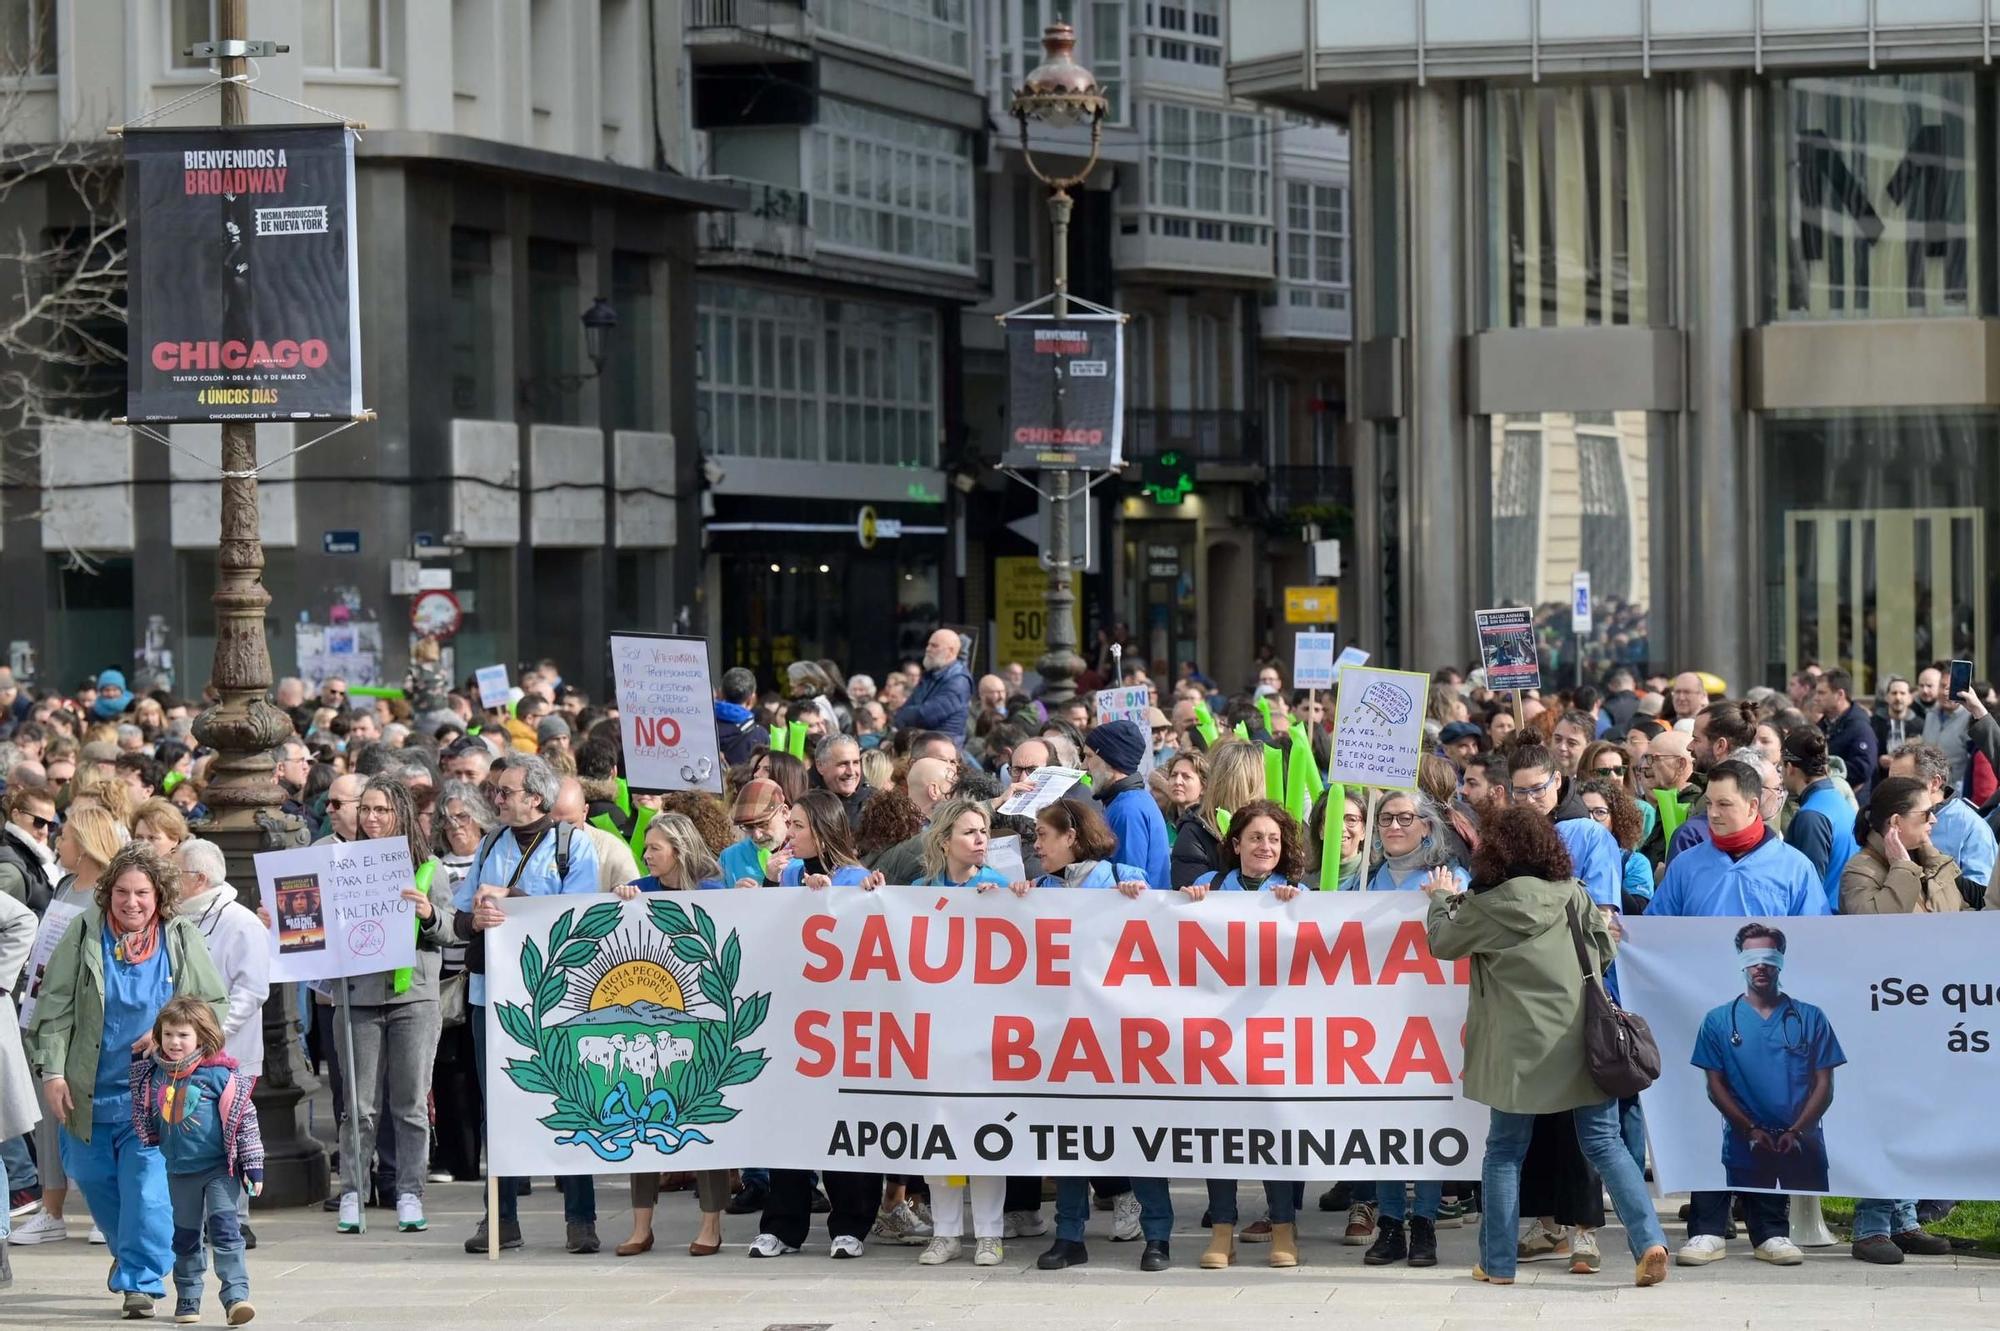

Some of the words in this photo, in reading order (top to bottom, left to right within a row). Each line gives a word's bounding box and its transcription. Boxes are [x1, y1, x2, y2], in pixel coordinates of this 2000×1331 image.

[184, 149, 276, 170] BIENVENIDOS
[277, 149, 287, 167] A
[185, 169, 287, 195] BROADWAY
[261, 211, 283, 220] MISMA
[283, 208, 323, 219] PRODUCCIÓN
[261, 221, 272, 232] DE
[273, 220, 299, 232] NUEVA
[301, 219, 323, 231] YORK
[152, 339, 328, 371] CHICAGO
[200, 374, 224, 382] COLÓN
[197, 390, 204, 405] 4
[207, 387, 249, 405] ÚNICOS
[252, 386, 278, 404] DÍAS
[209, 412, 268, 420] CHICAGOMUSICAL.ES
[1015, 428, 1104, 445] CHICAGO
[622, 646, 641, 660] SOY
[622, 663, 633, 674] MI
[623, 678, 635, 689] NO
[637, 680, 646, 689] SE
[626, 691, 638, 702] MI
[635, 716, 681, 748] NO
[1337, 739, 1373, 749] MEXAN
[1376, 743, 1394, 751] POR
[1399, 746, 1418, 755] MIN
[1337, 760, 1365, 770] DECIR
[1368, 763, 1385, 772] QUE
[1387, 766, 1417, 778] CHOVE
[1378, 755, 1395, 764] QUE
[329, 858, 357, 872] PARA
[363, 856, 377, 867] EL
[381, 851, 409, 862] PERRO
[336, 875, 362, 887] PARA
[366, 873, 379, 884] EL
[382, 868, 410, 881] GATO
[333, 891, 360, 901] ESTO
[365, 889, 378, 897] ES
[335, 899, 409, 920] MALTRATO
[801, 896, 1072, 986] SAÚDE
[600, 969, 630, 994] HIGIA
[633, 966, 675, 993] PECORIS
[605, 977, 634, 1004] SALUS
[637, 976, 669, 1003] POPULI
[1870, 977, 1929, 1012] ¡Se
[1942, 983, 2000, 1013] qu
[1947, 1022, 1990, 1053] ás
[793, 1009, 931, 1080] SEN
[991, 1015, 1465, 1086] BARREIRA
[827, 1120, 957, 1161] APOIA
[1029, 1125, 1115, 1162] TEU
[1132, 1126, 1470, 1167] VETERINARIO
